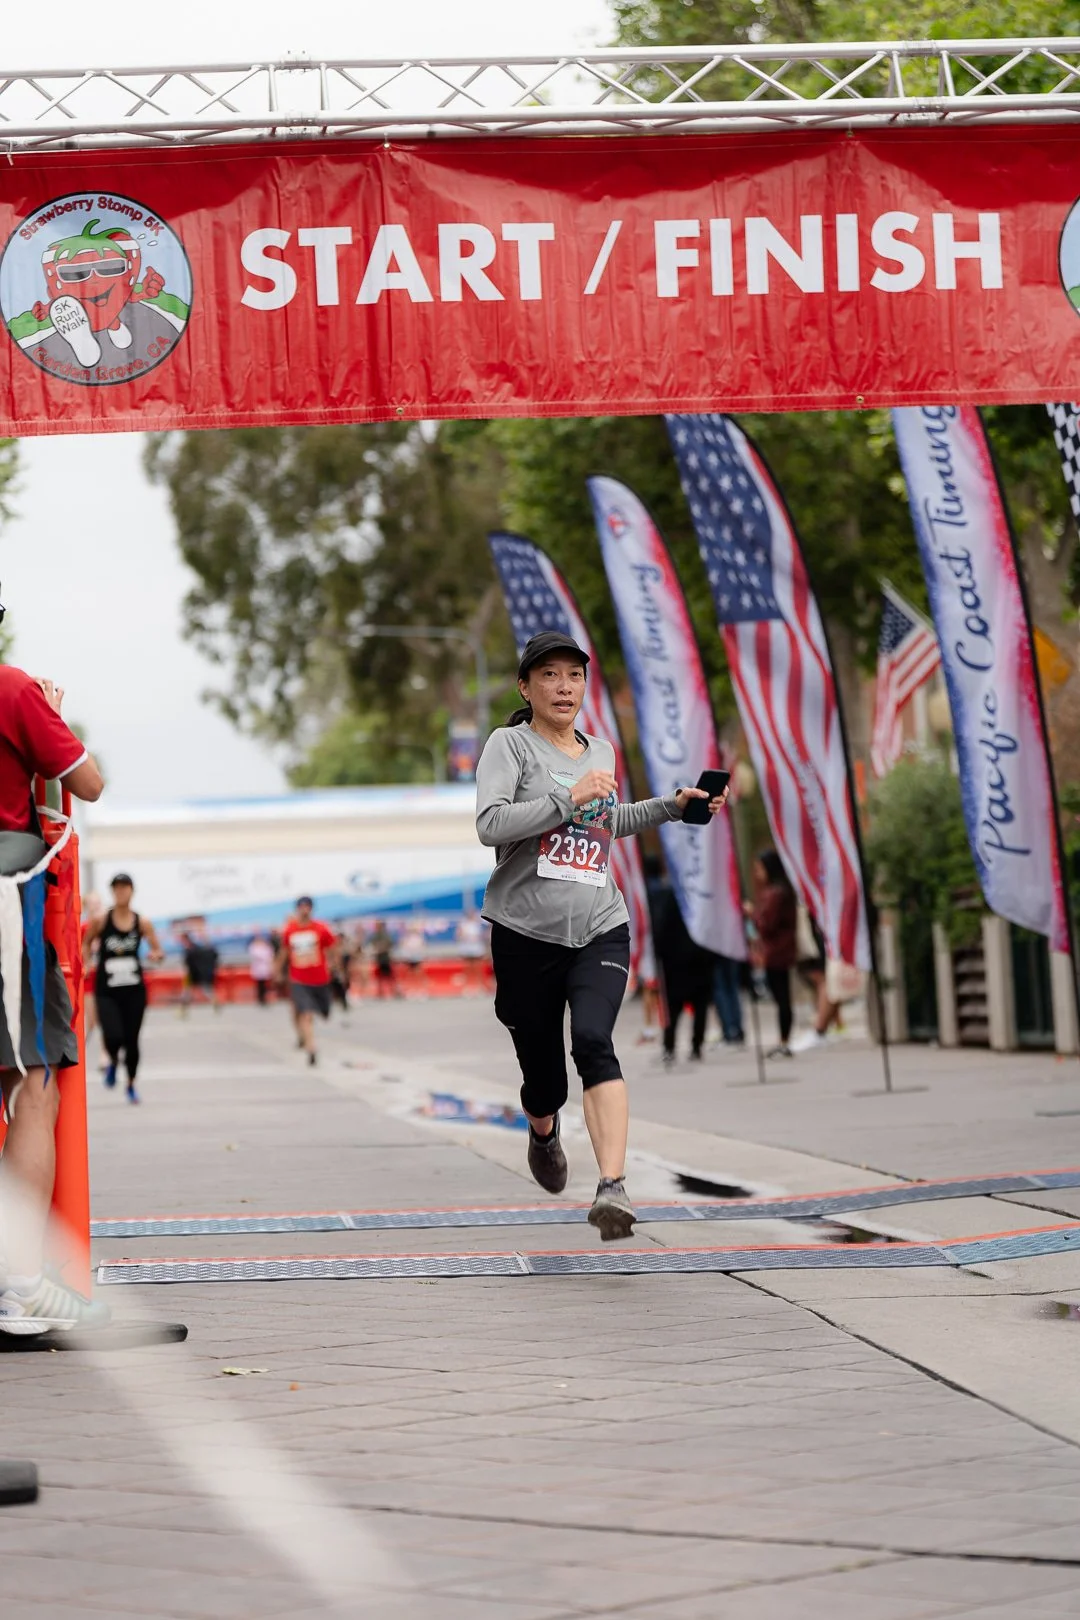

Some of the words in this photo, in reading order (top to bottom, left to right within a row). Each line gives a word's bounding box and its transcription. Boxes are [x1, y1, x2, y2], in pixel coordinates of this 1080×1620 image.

[18, 197, 94, 241] Strawberry
[97, 196, 144, 222] Stomp
[143, 216, 166, 237] 5K
[239, 222, 555, 311] START
[584, 219, 624, 296] /
[655, 212, 1004, 299] FINISH
[54, 300, 73, 315] 5K
[55, 309, 81, 326] Run/
[57, 315, 88, 336] Walk
[32, 346, 91, 381] Garden
[147, 335, 171, 358] CA
[939, 546, 994, 671] Coast
[978, 686, 1032, 864] Pacific
[547, 833, 601, 869] 2332
